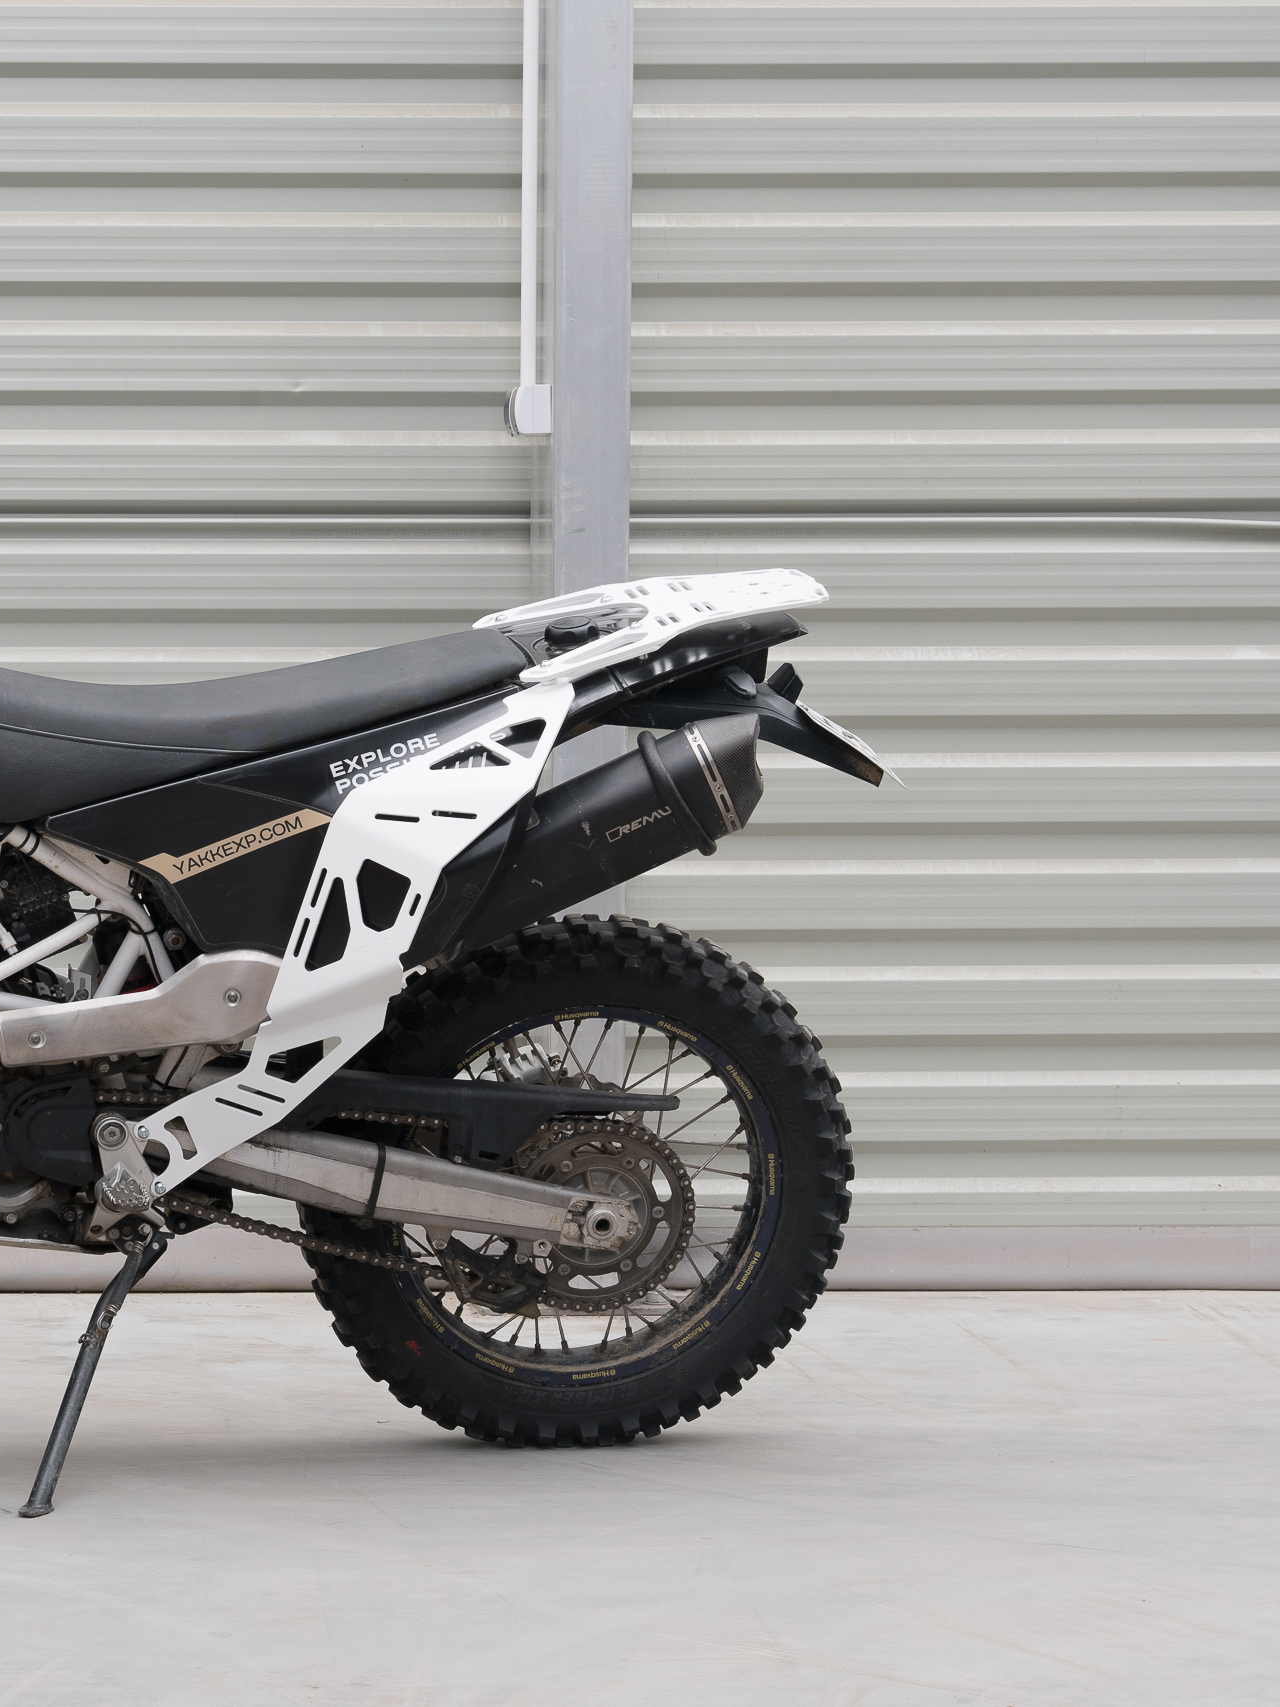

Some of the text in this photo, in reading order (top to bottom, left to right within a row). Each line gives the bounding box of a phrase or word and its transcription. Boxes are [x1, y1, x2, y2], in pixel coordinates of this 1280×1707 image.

[329, 732, 441, 778] EXPLORE
[172, 815, 303, 875] YAKKEXP.COM
[558, 1011, 600, 1020] Husqvarna
[662, 1022, 698, 1042] Husqvarna
[460, 1041, 496, 1066] Husqvarna
[729, 1069, 753, 1100] Husqvarna
[767, 1159, 776, 1196] Husqvarna
[735, 1254, 760, 1291] Husqvarna
[672, 1324, 706, 1350] Husqvarna
[475, 1352, 509, 1372] Husqvarna
[572, 1370, 610, 1380] Husqvarna
